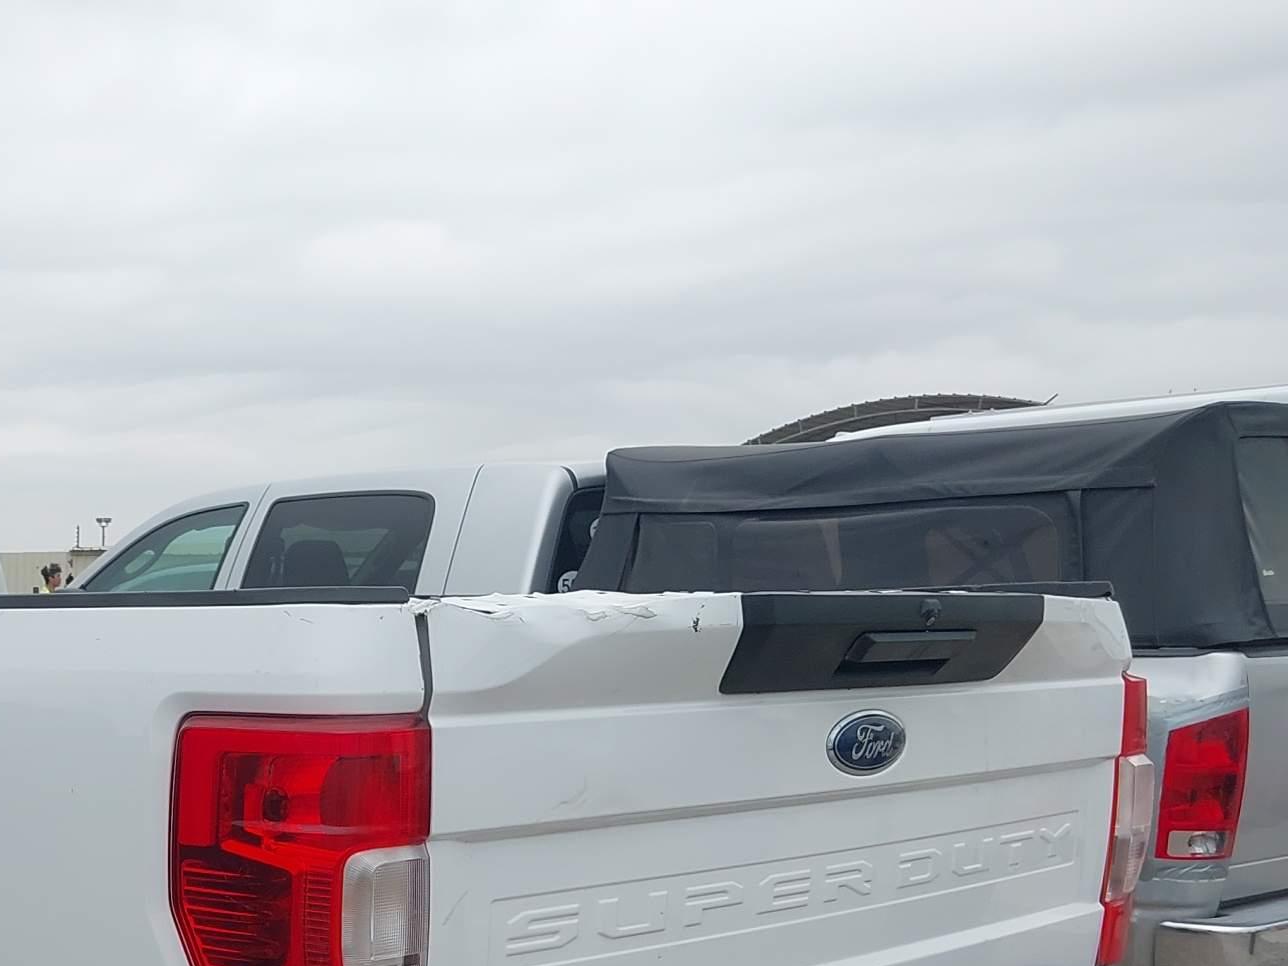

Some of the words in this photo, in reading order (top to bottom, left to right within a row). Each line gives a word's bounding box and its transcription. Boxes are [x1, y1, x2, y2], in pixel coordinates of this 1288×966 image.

[852, 724, 894, 760] Ford
[505, 859, 873, 957] SUPER
[896, 823, 1071, 890] DUTY
